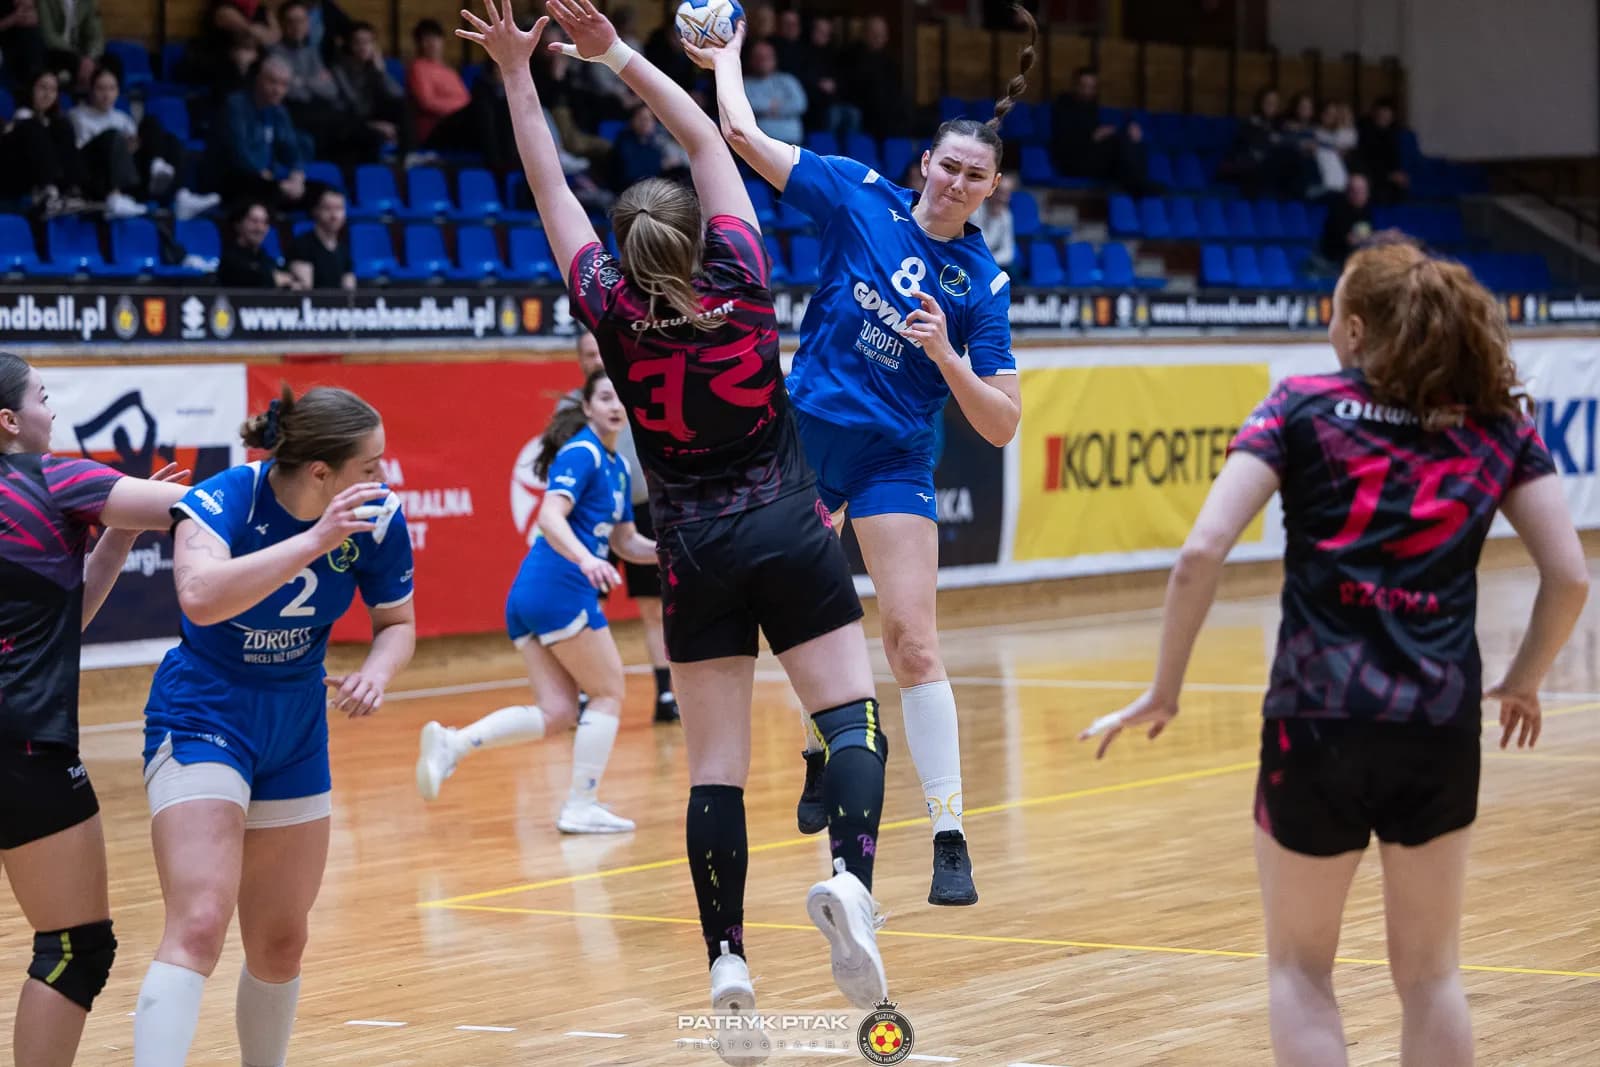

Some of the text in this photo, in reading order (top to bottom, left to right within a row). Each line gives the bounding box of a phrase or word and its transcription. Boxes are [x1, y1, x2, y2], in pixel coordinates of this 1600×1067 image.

[891, 256, 926, 298] 8
[239, 296, 496, 337] www.koronahandball.pl
[853, 281, 925, 349] GDYN
[628, 330, 776, 443] 32
[1535, 396, 1598, 476] KI
[1316, 455, 1482, 559] 15
[279, 566, 319, 617] 2
[243, 626, 313, 650] ZDROFIT
